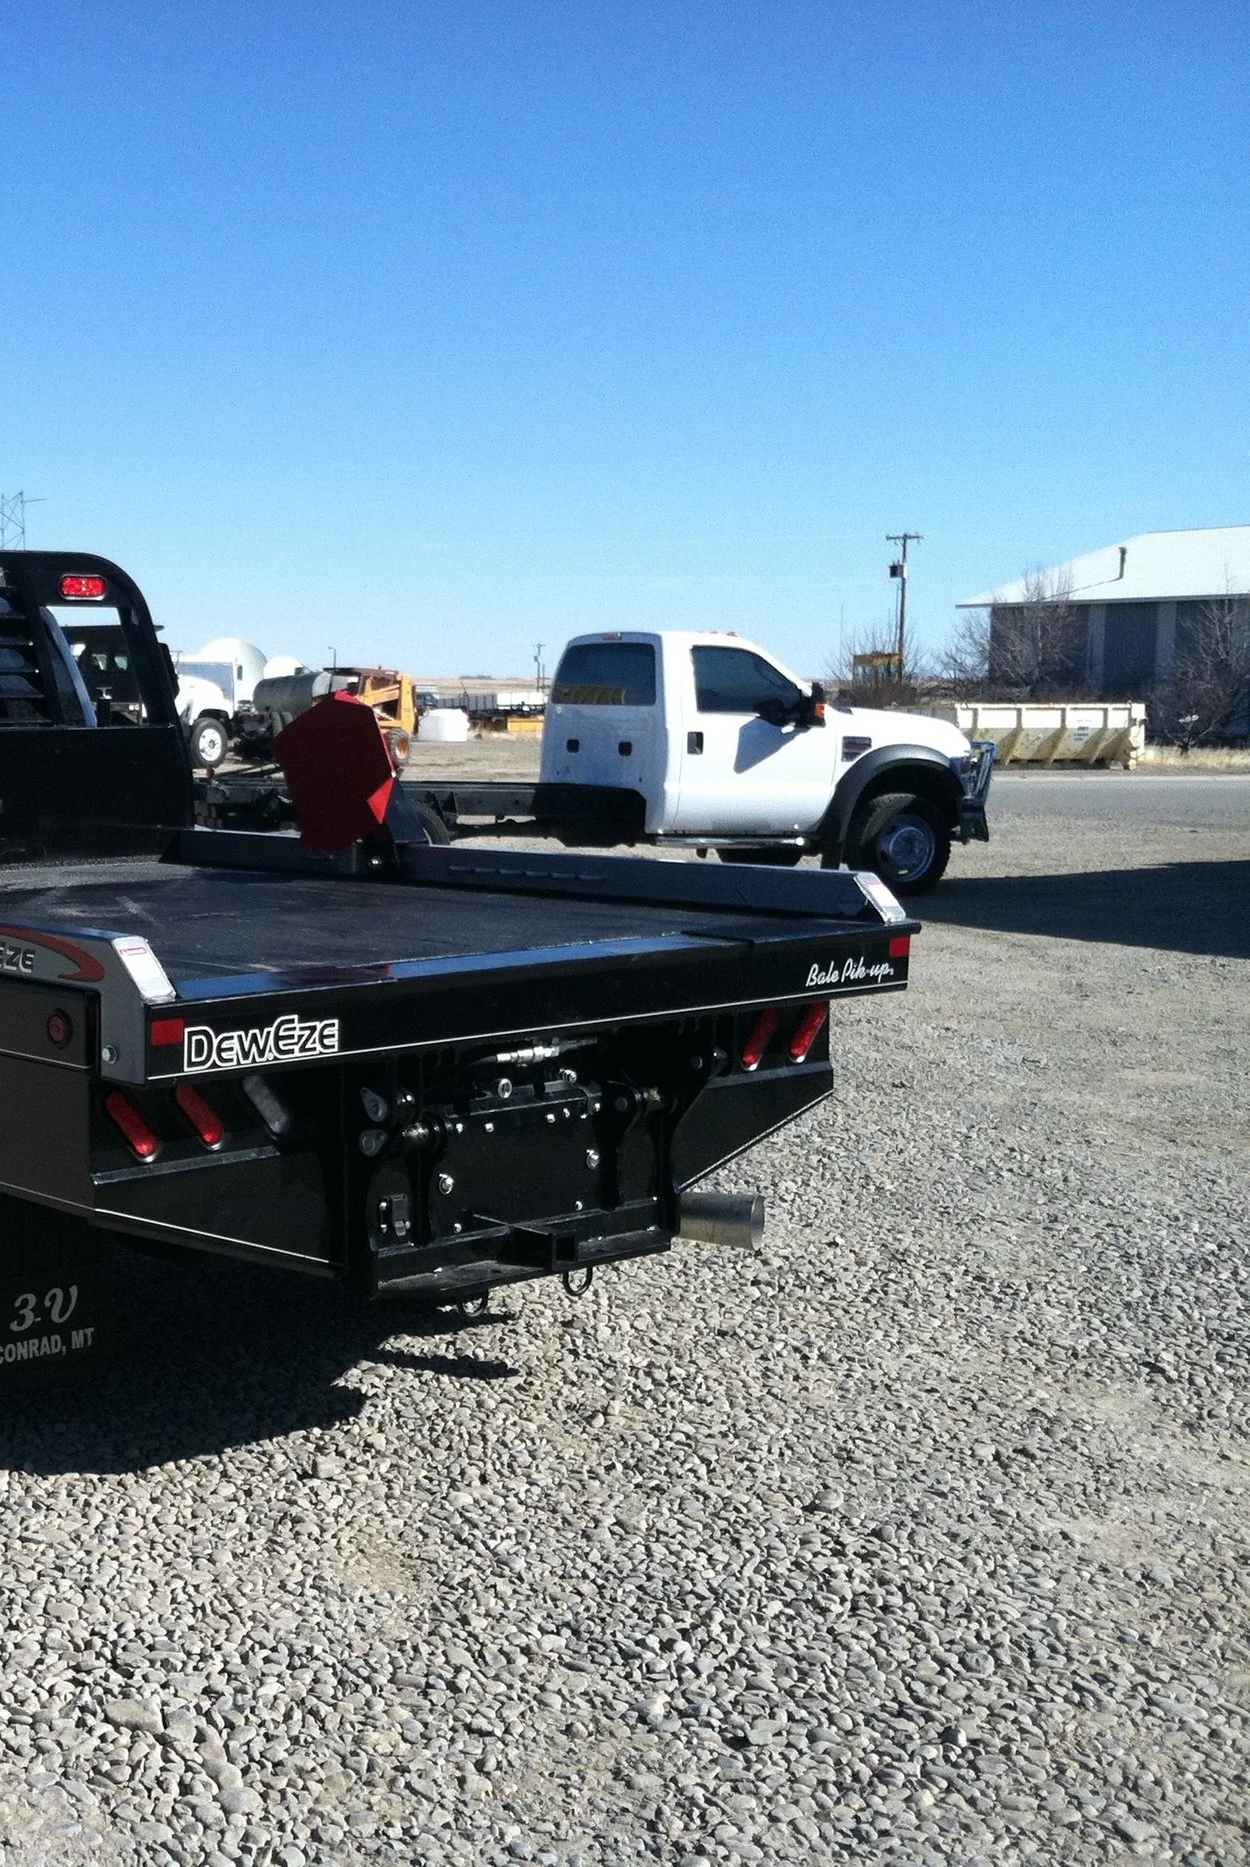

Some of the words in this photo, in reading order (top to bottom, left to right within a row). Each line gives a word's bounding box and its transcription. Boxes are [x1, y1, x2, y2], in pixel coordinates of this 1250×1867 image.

[805, 960, 840, 987] Bale
[9, 1284, 79, 1332] 3-V
[71, 1327, 95, 1350] MT
